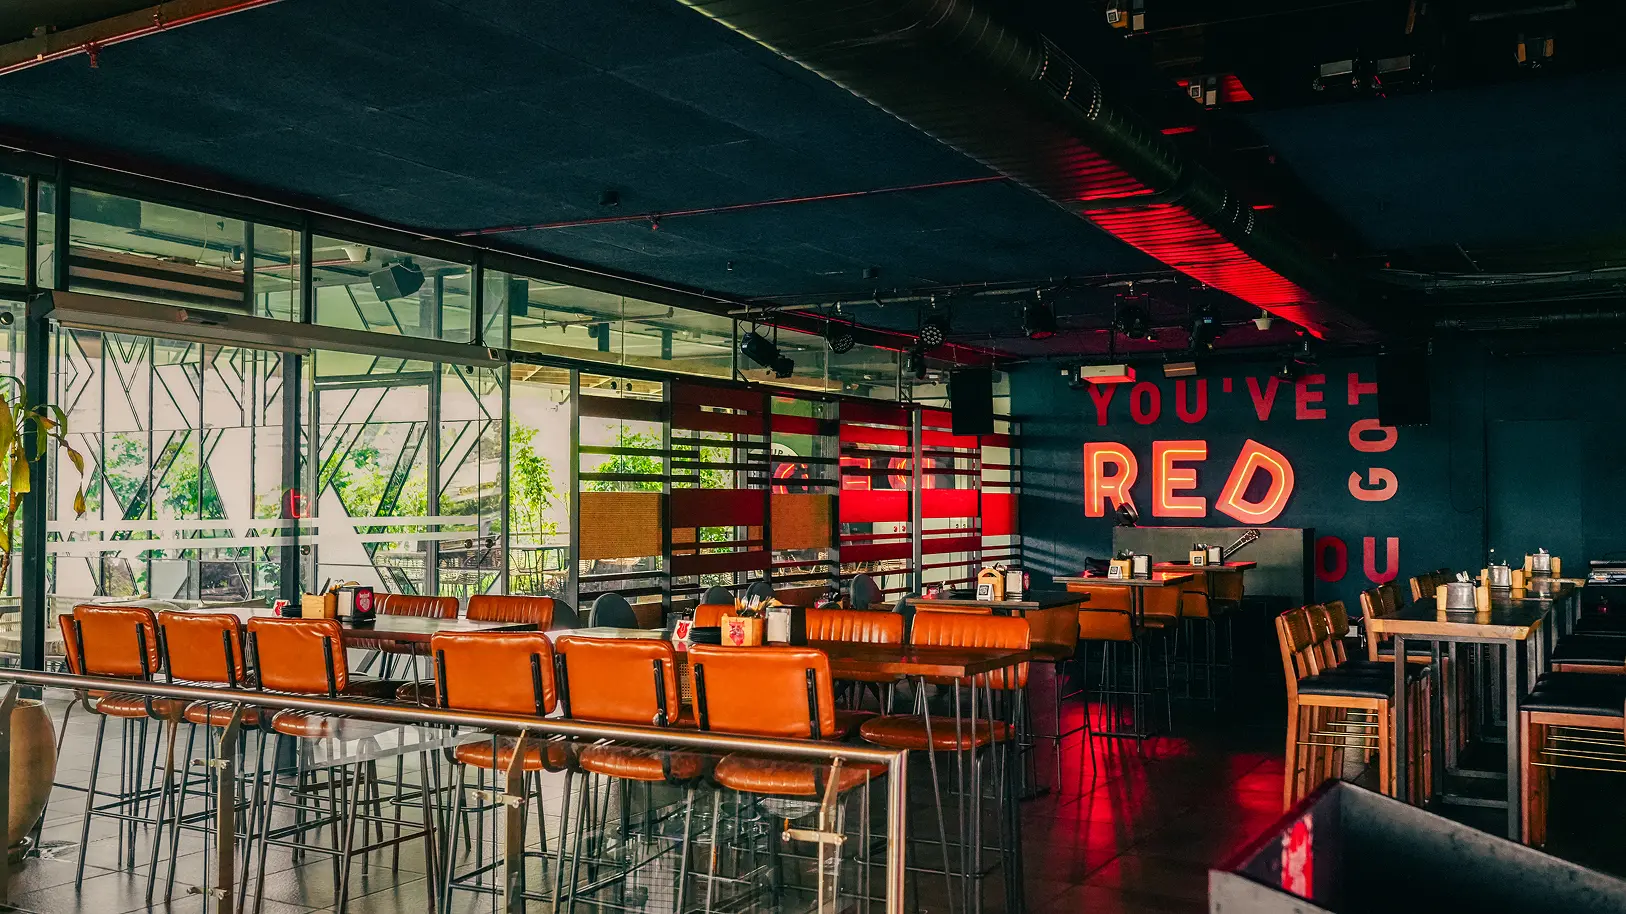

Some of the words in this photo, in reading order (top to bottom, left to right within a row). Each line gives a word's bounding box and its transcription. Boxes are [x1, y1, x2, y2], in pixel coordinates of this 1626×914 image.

[1088, 374, 1327, 426] YOU'VE
[1348, 372, 1399, 502] GOT
[1083, 438, 1295, 525] RED
[1315, 536, 1399, 585] OU
